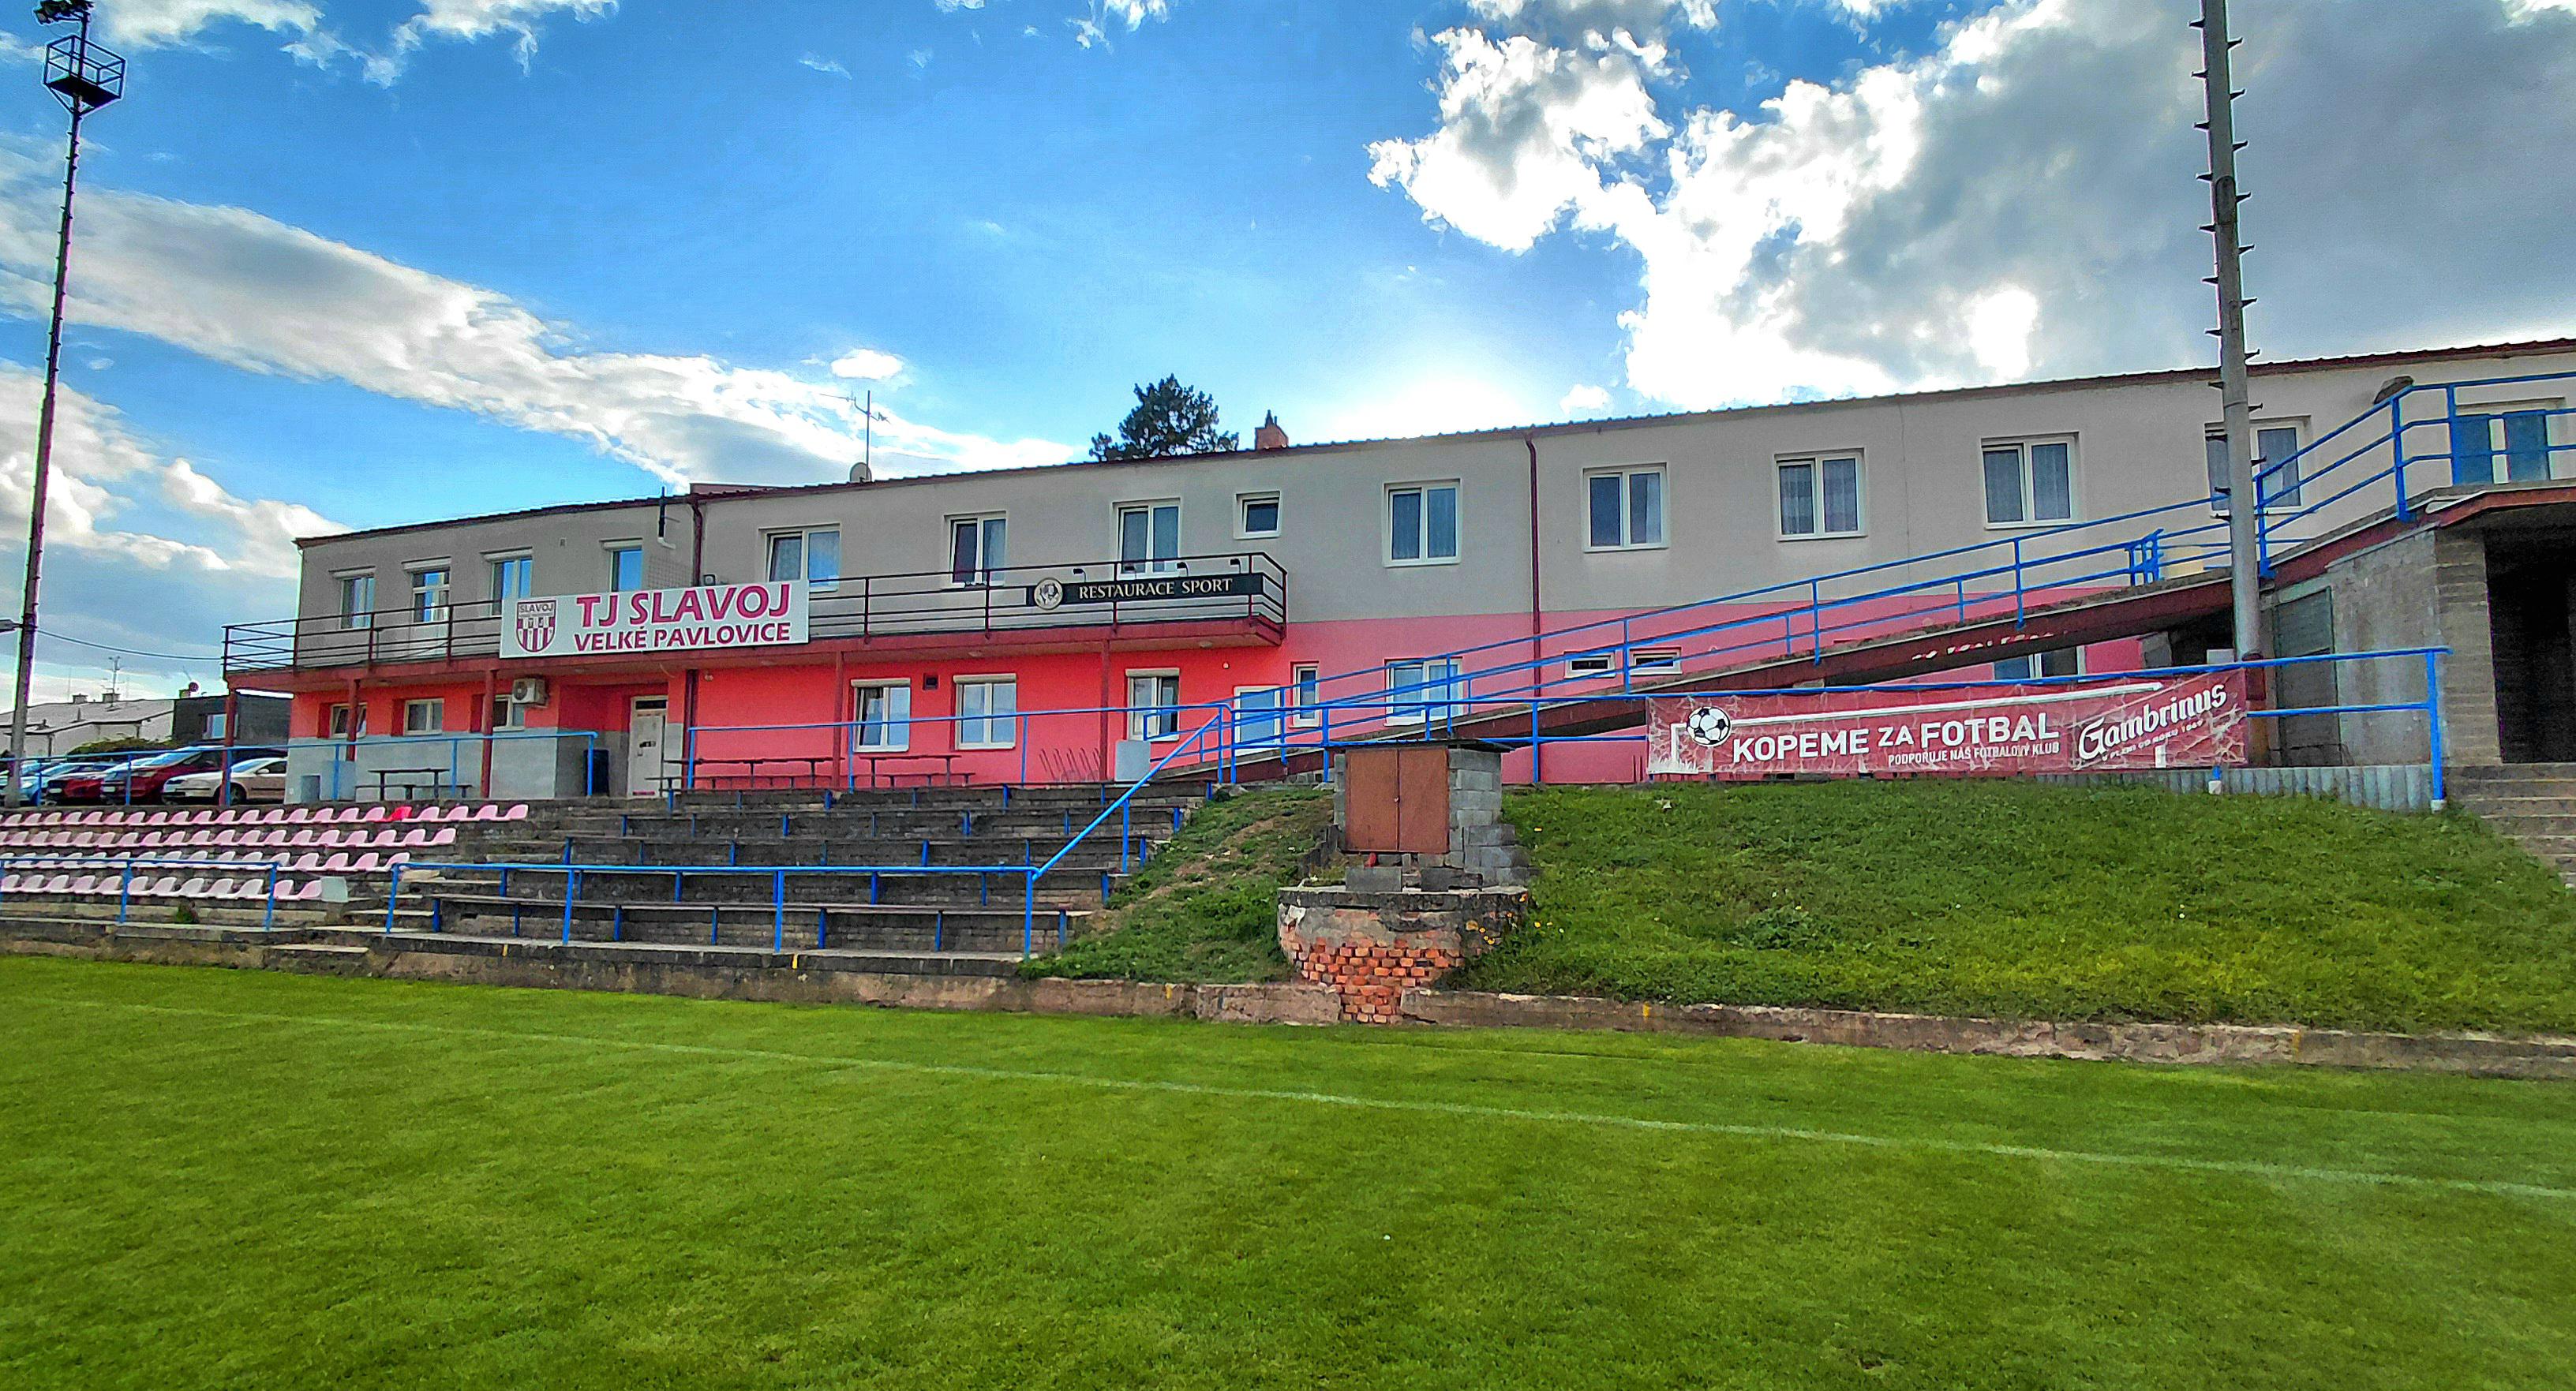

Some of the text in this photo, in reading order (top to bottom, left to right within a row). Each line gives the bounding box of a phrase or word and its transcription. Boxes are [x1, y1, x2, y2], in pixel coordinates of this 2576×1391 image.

[1079, 578, 1233, 600] RESTAURACE SPORT
[520, 603, 554, 613] SLAVOJ
[576, 583, 791, 628] TJ SLAVOJ
[575, 623, 791, 652] VELKÉ PAVLOVICE
[2078, 683, 2228, 761] Gambrinus
[1733, 712, 2060, 764] KOPEME ZA FOTBAL
[1888, 742, 2060, 768] PODPORUJE NÁŠ FOTBALOVÝ KLUB
